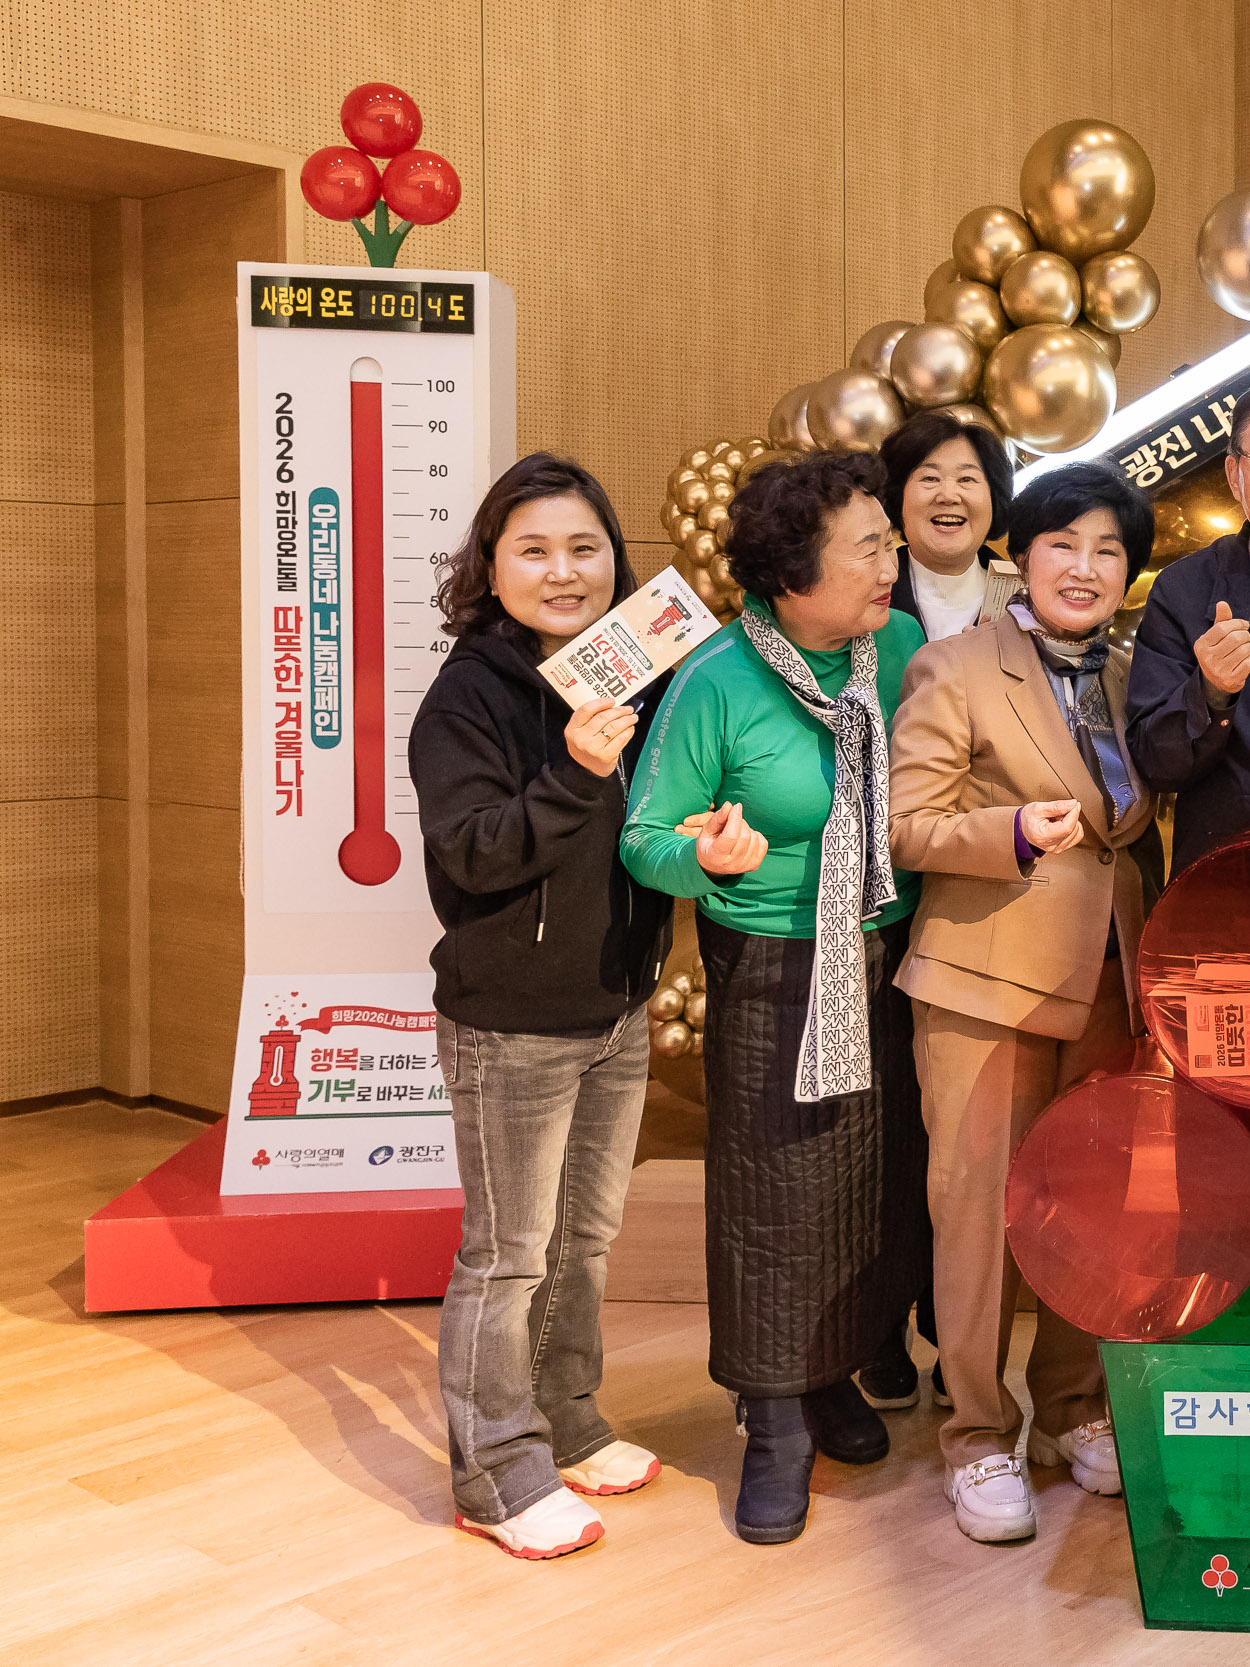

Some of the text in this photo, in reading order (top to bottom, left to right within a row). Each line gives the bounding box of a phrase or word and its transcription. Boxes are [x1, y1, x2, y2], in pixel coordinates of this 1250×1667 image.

[261, 285, 312, 318] 사랑의
[319, 288, 354, 318] 온도
[426, 379, 455, 392] 100
[428, 420, 448, 434] 90
[1119, 424, 1198, 488] 광진
[429, 465, 448, 477] 80
[275, 392, 298, 592] 2026 희망온돌
[429, 509, 448, 521] 70
[430, 552, 448, 565] 60
[312, 503, 339, 737] 우리동네 나눔캠페인
[430, 641, 449, 653] 40
[577, 643, 627, 698] 따뜻한
[592, 634, 639, 686] 겨울나기
[593, 684, 611, 698] 026
[273, 606, 304, 817] 따뜻한 겨울나기
[657, 696, 678, 744] master
[650, 747, 661, 776] golf
[1225, 1004, 1245, 1067] 따뜻한
[310, 1048, 374, 1072] 행복을
[379, 1054, 426, 1070] 더하는
[1217, 1044, 1225, 1066] 2026
[307, 1079, 372, 1102] 기부로
[376, 1085, 424, 1101] 바꾸는
[399, 1145, 445, 1158] 광진구
